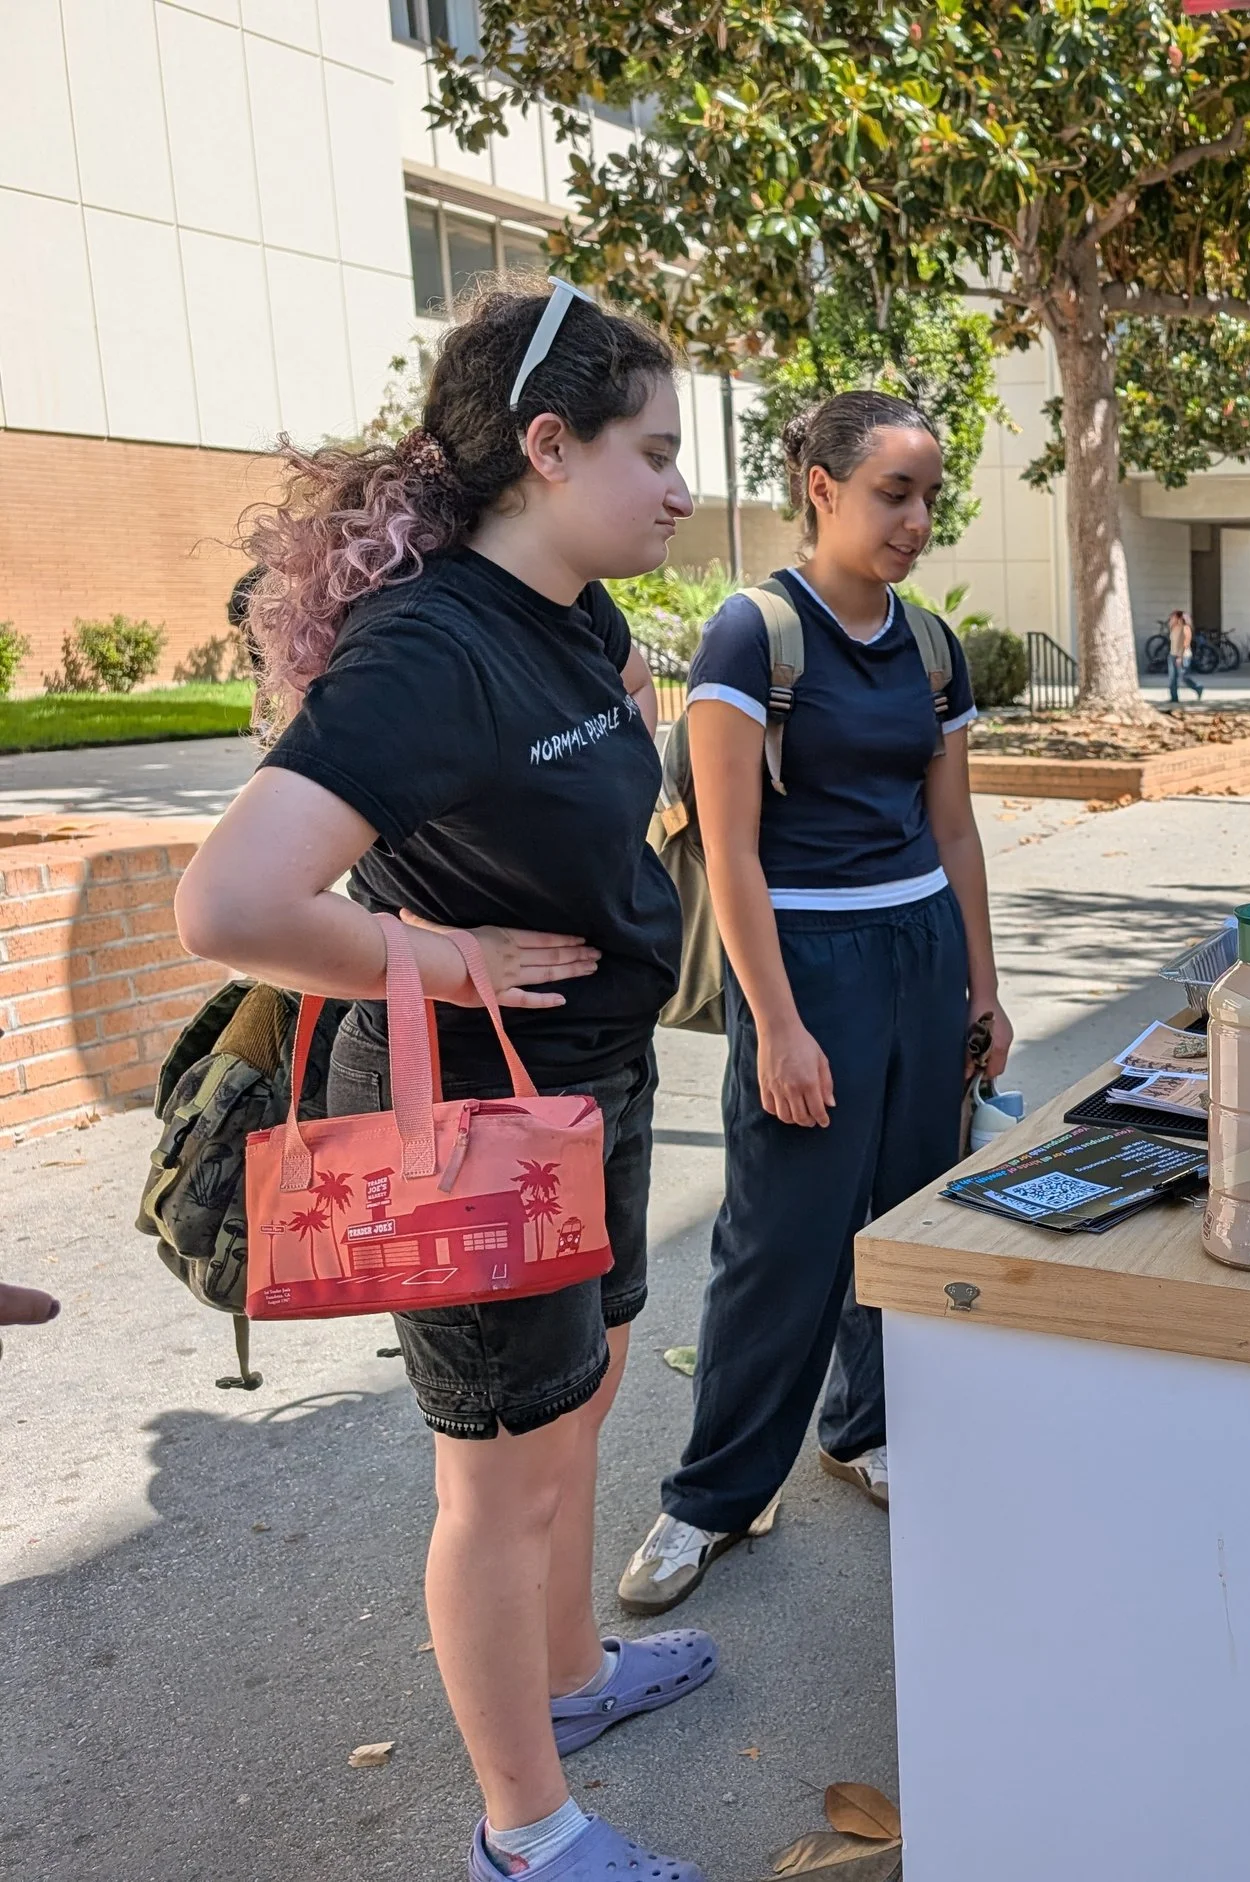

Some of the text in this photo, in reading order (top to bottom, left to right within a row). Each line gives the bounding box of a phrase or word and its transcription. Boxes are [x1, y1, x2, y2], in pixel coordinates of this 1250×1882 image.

[530, 725, 588, 765] NORMAL
[584, 706, 620, 744] PEOPLE
[1072, 1126, 1090, 1137] Your
[1113, 1127, 1135, 1137] Your
[1044, 1134, 1073, 1149] campus
[1080, 1134, 1114, 1148] campus
[1064, 1145, 1084, 1154] hub
[1040, 1155, 1053, 1163] all
[1006, 1166, 1017, 1175] of
[367, 1183, 387, 1194] JOE'S
[348, 1221, 393, 1238] TRADER JOE'S
